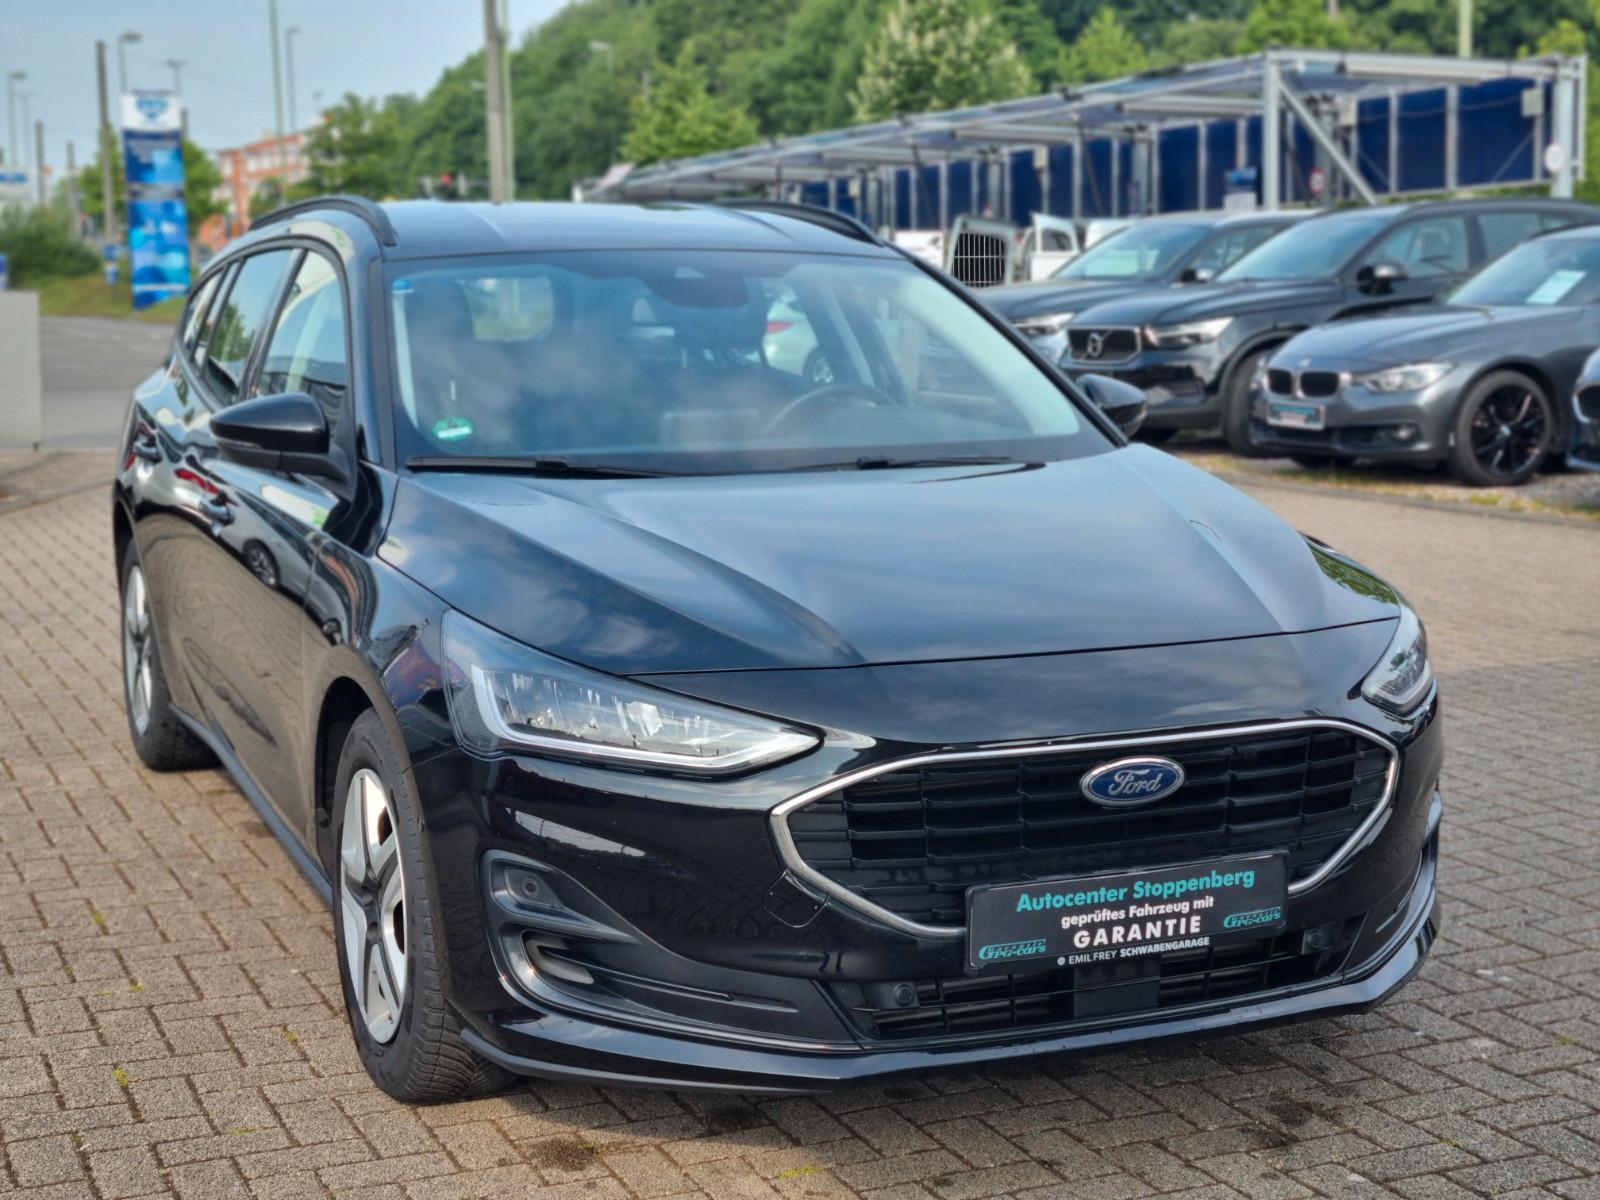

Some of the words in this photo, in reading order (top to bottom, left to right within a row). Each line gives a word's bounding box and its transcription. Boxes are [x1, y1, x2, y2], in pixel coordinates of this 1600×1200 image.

[1108, 768, 1162, 796] Ford
[1016, 886, 1128, 912] Autocenter
[1132, 869, 1255, 900] Stoppenberg
[1061, 909, 1126, 930] geprüftes
[1128, 901, 1190, 919] Fahrzeug
[1192, 895, 1215, 911] mit
[1073, 915, 1202, 949] GARANTIE
[1068, 955, 1093, 966] EMIL
[1093, 950, 1117, 963] FREY
[1119, 936, 1210, 958] SCHWABENGARAGE
